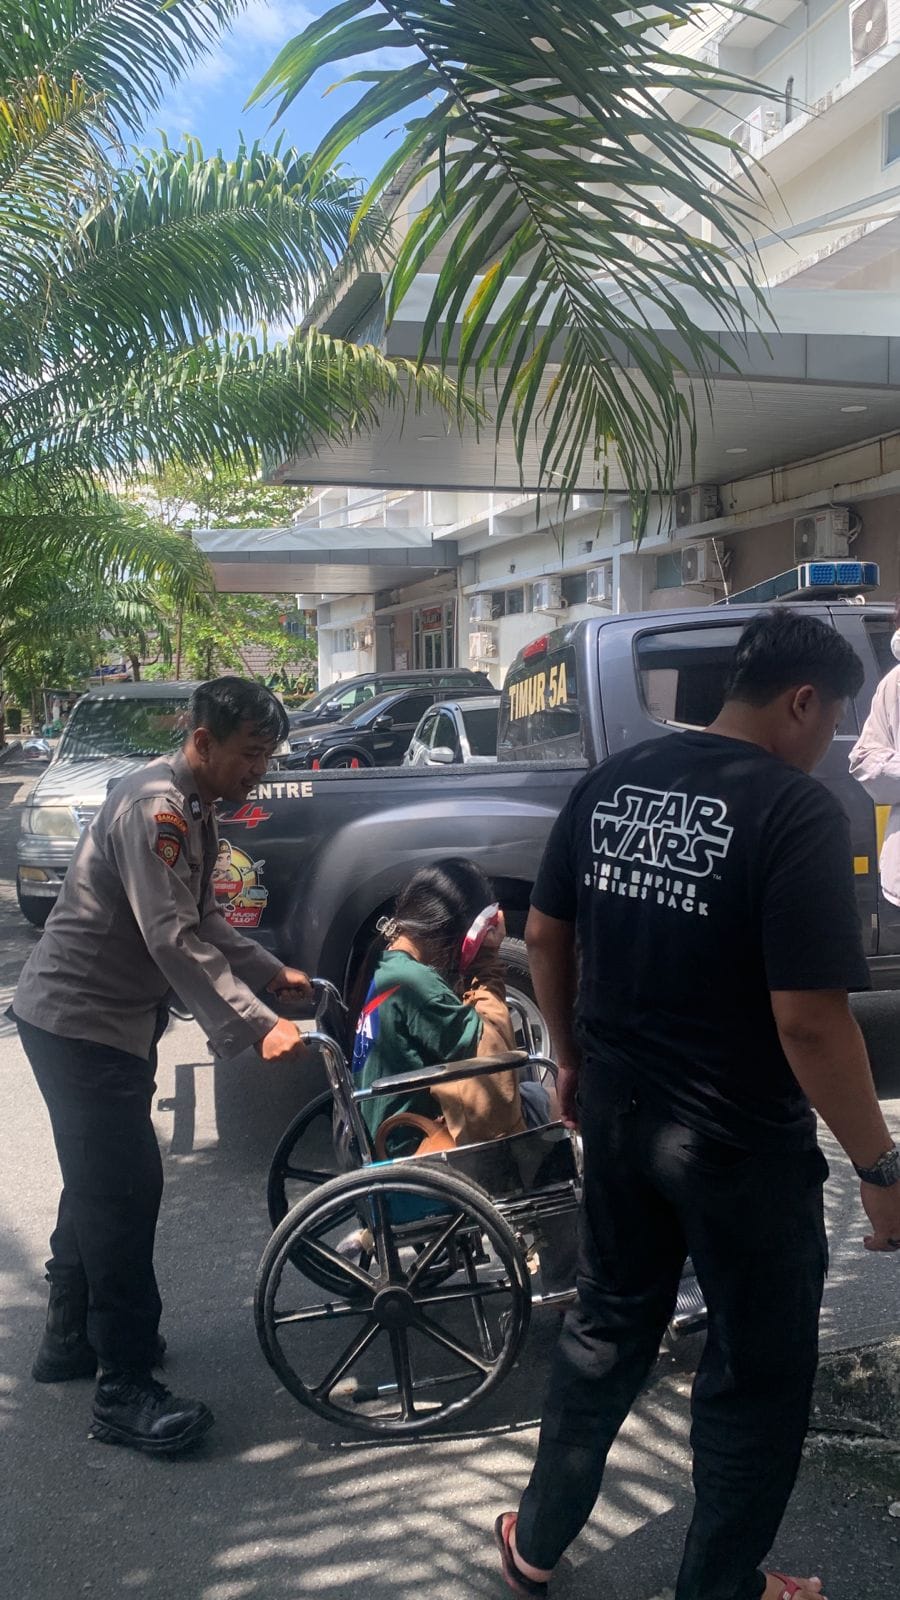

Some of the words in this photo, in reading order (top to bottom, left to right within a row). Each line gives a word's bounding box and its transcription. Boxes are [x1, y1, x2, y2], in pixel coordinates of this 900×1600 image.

[509, 672, 546, 721] TIMUR
[549, 662, 568, 708] 5A
[246, 781, 314, 800] ENTRE
[592, 784, 734, 843] STAR
[591, 815, 728, 878] WARS
[584, 873, 648, 900] STRIKES
[593, 861, 622, 880] THE
